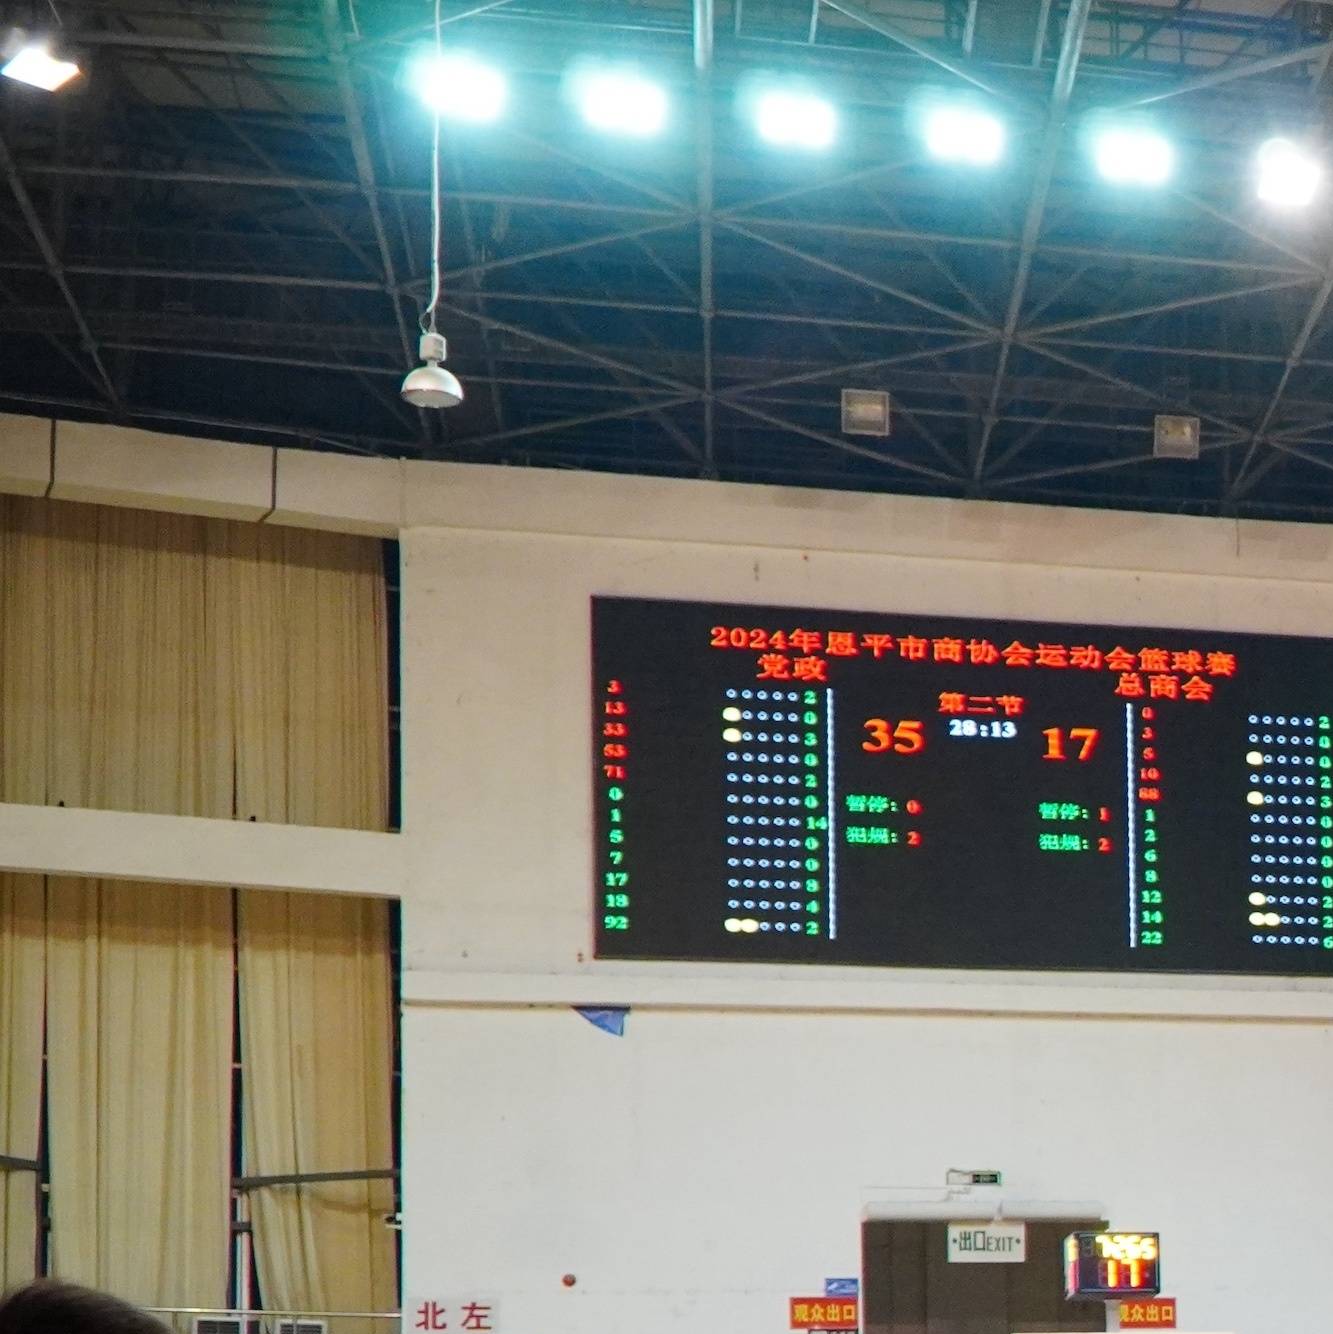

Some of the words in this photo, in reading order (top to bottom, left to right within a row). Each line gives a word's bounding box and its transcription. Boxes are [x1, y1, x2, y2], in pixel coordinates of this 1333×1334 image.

[711, 626, 1237, 677] 2024年恩平市商协会运动会篮球赛
[756, 653, 828, 682] 党政
[1114, 672, 1213, 700] 总商会
[803, 690, 818, 705] 2
[938, 691, 1025, 716] 第二节
[949, 718, 1017, 738] 28:13
[1318, 715, 1331, 730] 2
[803, 732, 818, 747] 3
[861, 718, 926, 754] 35
[1141, 726, 1156, 741] 3
[1042, 727, 1099, 761] 17
[803, 773, 819, 788] 2
[1319, 775, 1333, 790] 2
[1319, 795, 1333, 809] 3
[609, 807, 622, 823] 1
[1144, 808, 1156, 822] 1
[805, 815, 828, 831] 14
[1143, 829, 1157, 843] 2
[609, 850, 624, 865] 7
[1143, 849, 1158, 863] 6
[605, 871, 628, 887] 17
[1141, 889, 1163, 905] 12
[805, 899, 820, 914] 4
[603, 914, 630, 931] 92
[805, 920, 820, 935] 2
[1141, 930, 1164, 945] 22
[415, 1301, 492, 1331] 北左
[794, 1303, 856, 1322] 观众出口
